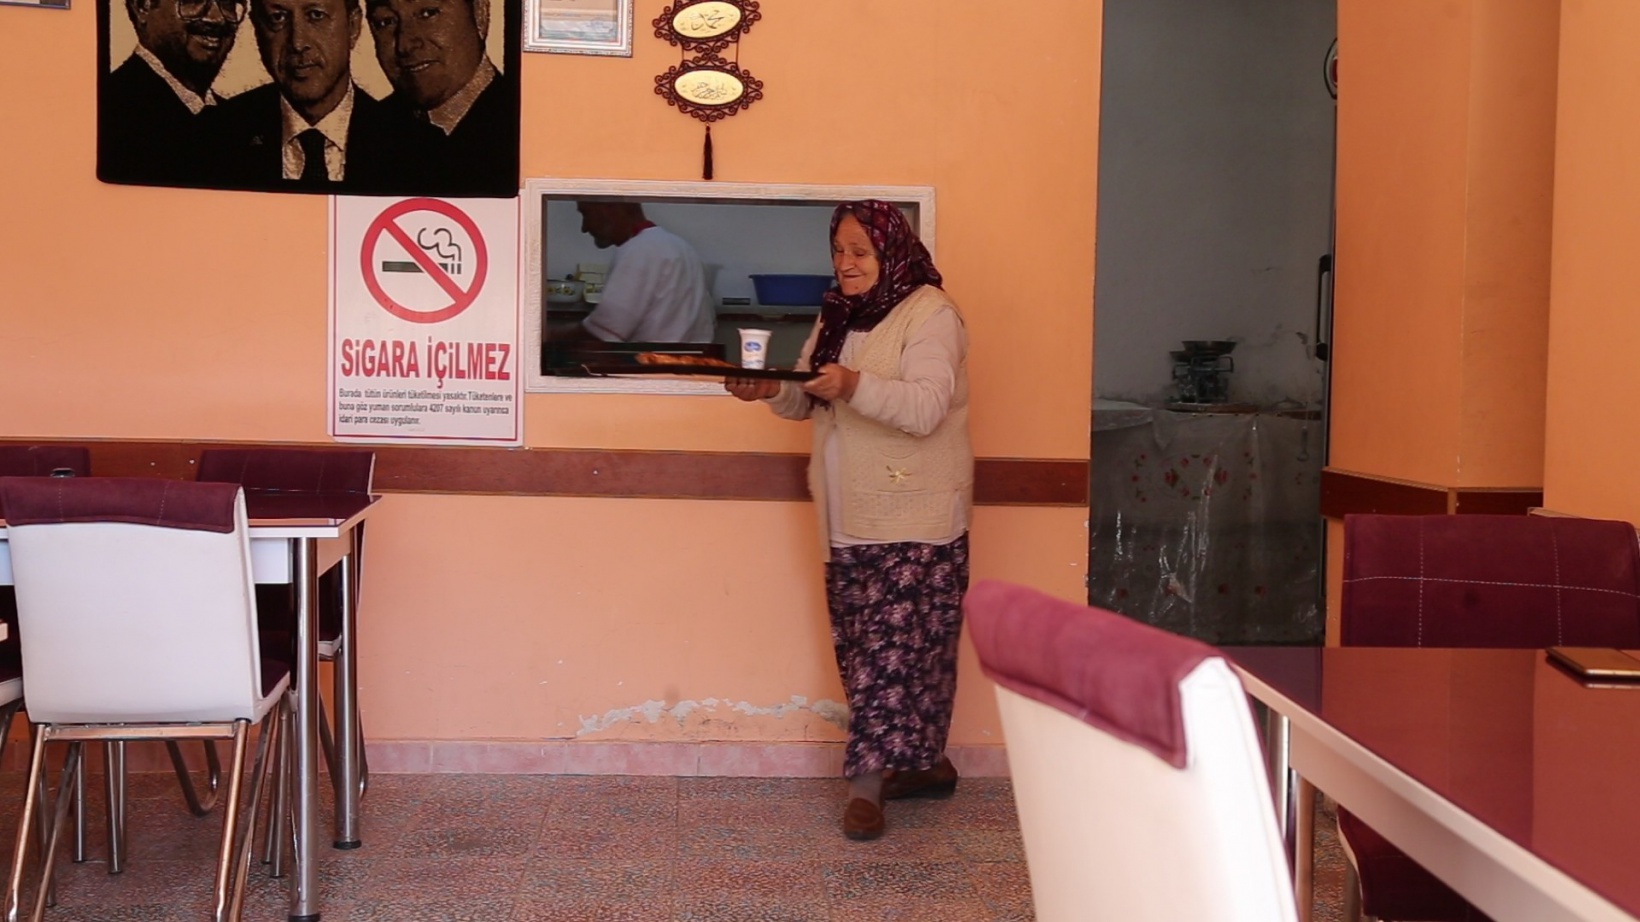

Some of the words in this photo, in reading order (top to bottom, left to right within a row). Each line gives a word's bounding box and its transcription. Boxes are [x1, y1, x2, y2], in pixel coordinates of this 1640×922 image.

[339, 388, 361, 398] Burada
[365, 388, 381, 398] tütün
[382, 388, 407, 398] ürünleri
[505, 394, 512, 402] ve
[339, 401, 355, 410] buna
[356, 401, 368, 412] göz
[369, 404, 390, 413] yuman
[463, 404, 482, 413] kanun
[354, 416, 368, 425] para
